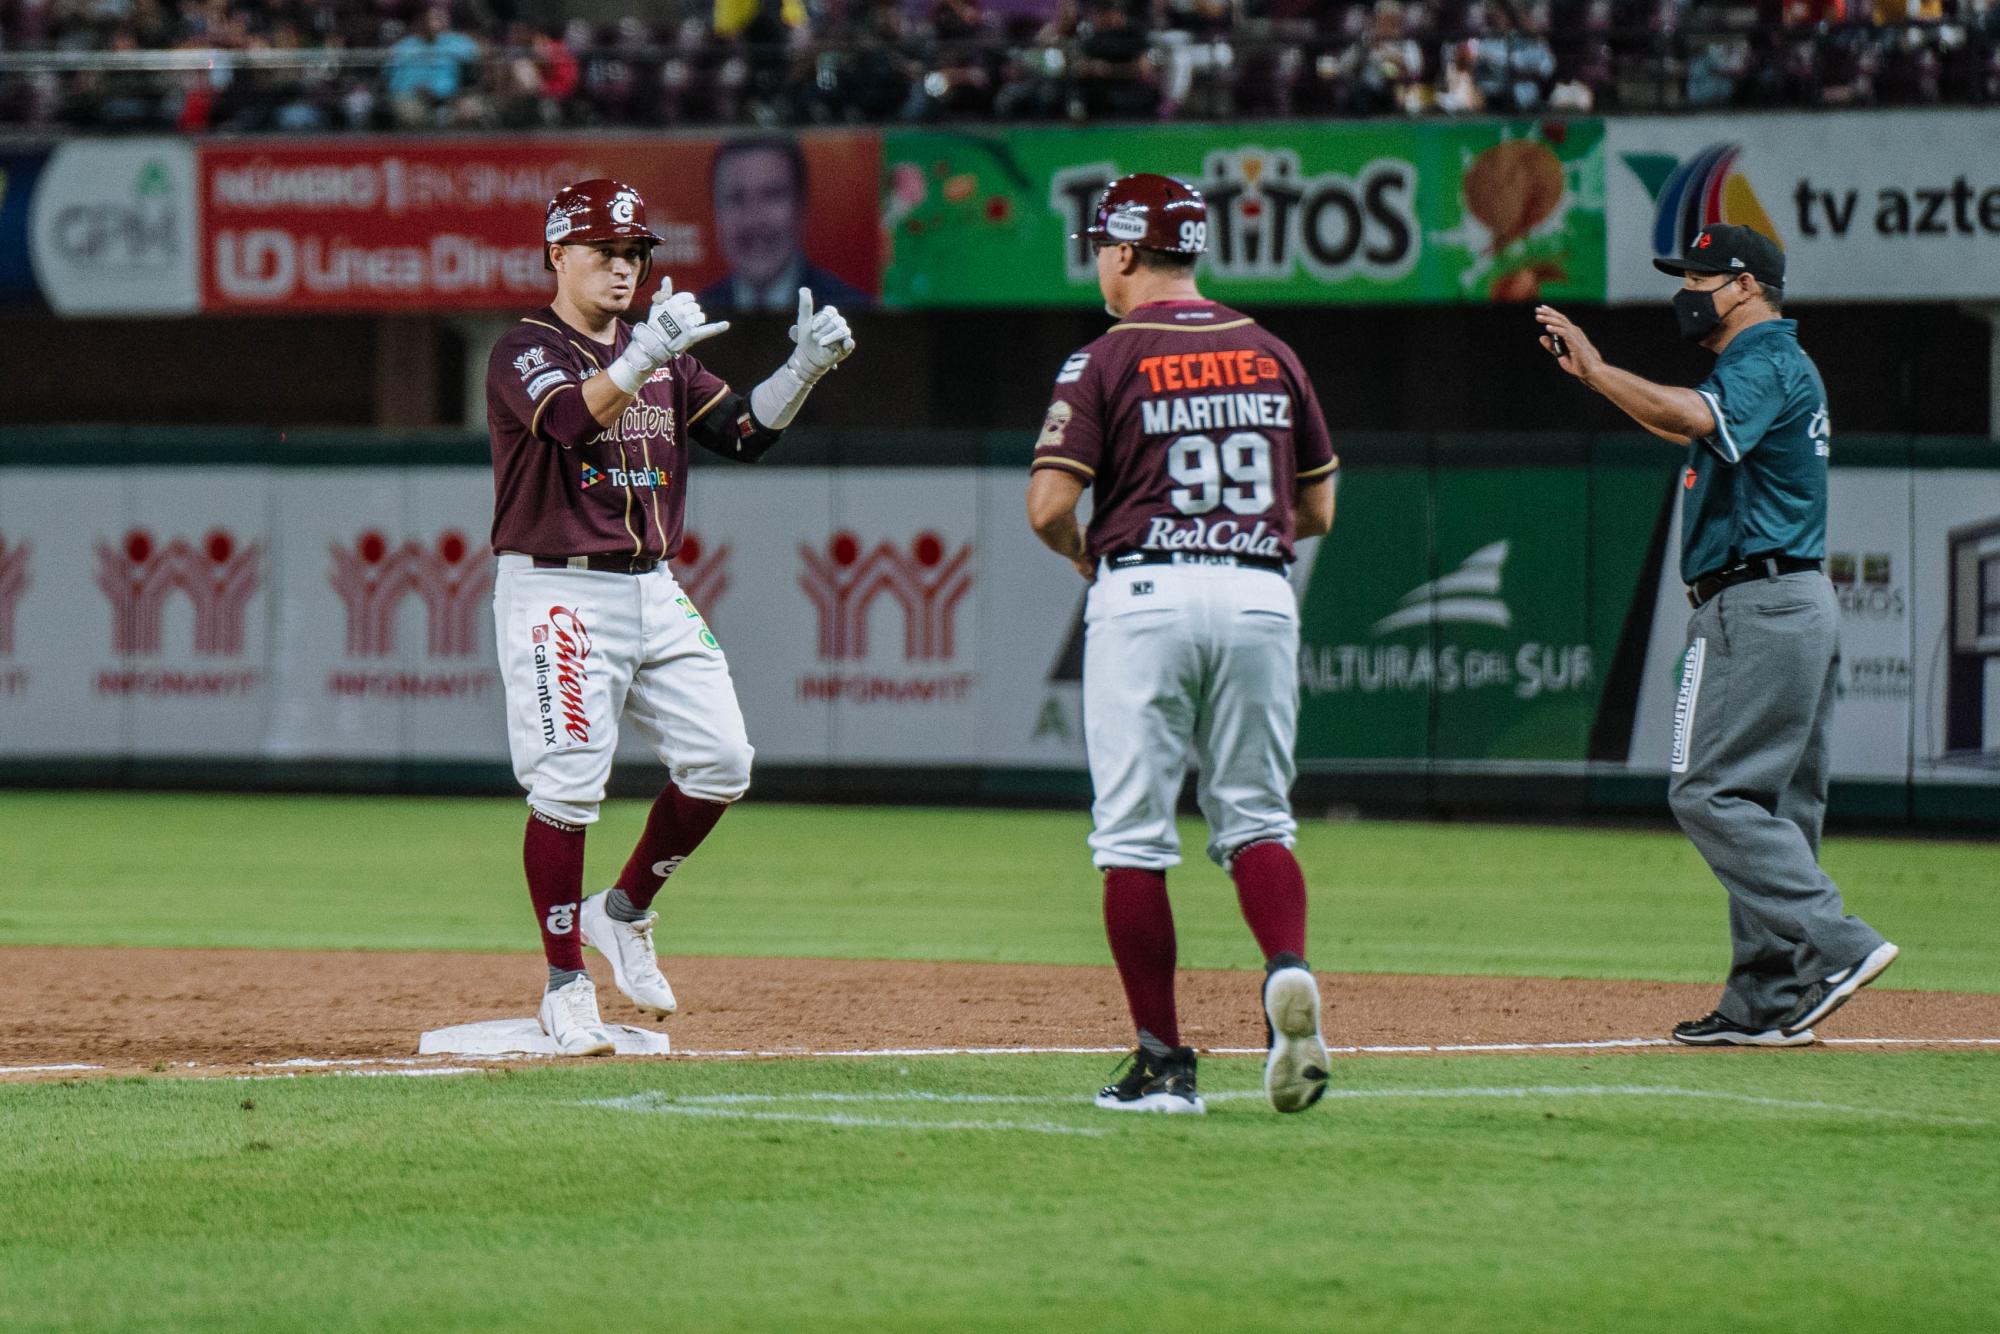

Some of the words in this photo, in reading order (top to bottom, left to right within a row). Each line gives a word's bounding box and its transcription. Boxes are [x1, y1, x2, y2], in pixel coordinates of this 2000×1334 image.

[1795, 175, 1858, 238] tv
[1874, 174, 2000, 239] azte
[431, 233, 557, 292] Direc
[1180, 220, 1206, 251] 99
[1138, 349, 1257, 393] TECATE
[1141, 393, 1292, 434] MARTINEZ
[607, 466, 668, 488] Totalpla
[1168, 431, 1274, 515] 99
[533, 645, 557, 747] caliente.mx
[1298, 643, 1460, 694] ALTURAS
[1515, 642, 1593, 698] SUR
[1672, 644, 1697, 758] PAQUETEXPRESS
